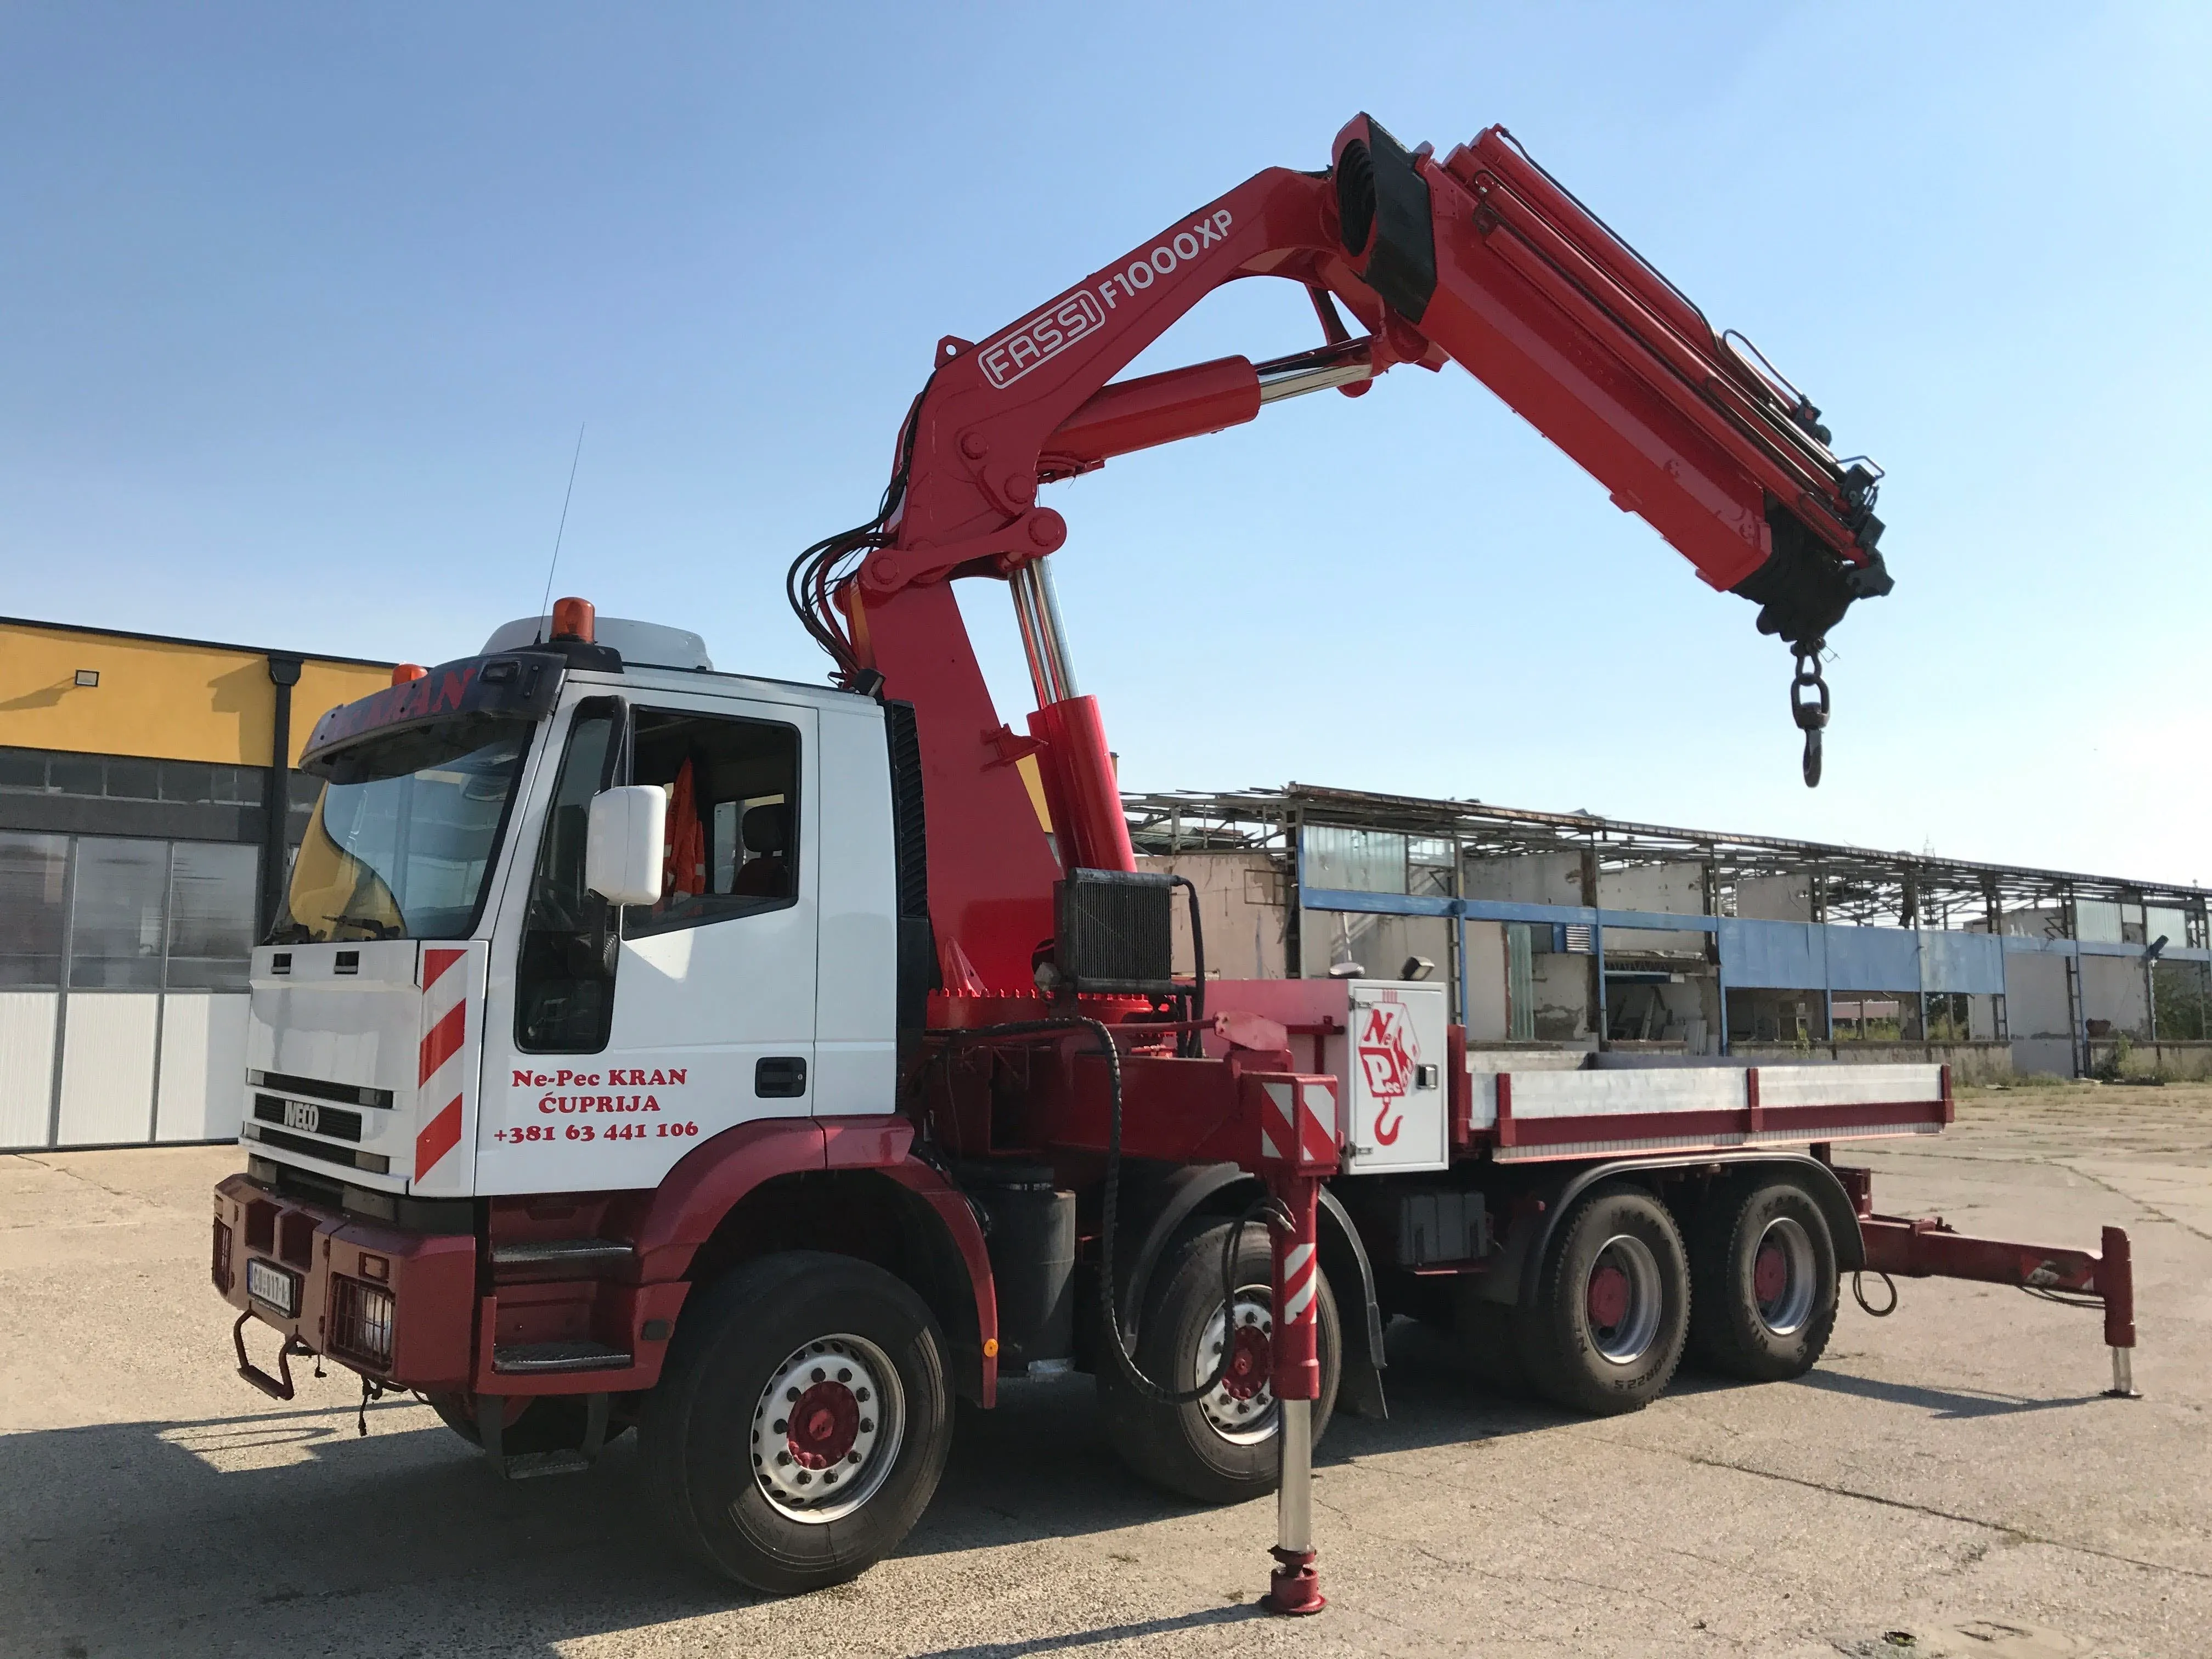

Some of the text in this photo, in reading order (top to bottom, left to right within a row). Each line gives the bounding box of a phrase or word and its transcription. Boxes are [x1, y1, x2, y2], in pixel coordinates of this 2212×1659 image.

[985, 209, 1233, 382] FASSI F1000XP
[511, 1069, 687, 1087] Ne-Pec KRAN
[538, 1091, 661, 1114] ĆUPRIJA
[284, 1101, 319, 1132] IVECO
[494, 1121, 699, 1144] +381 63 441 106
